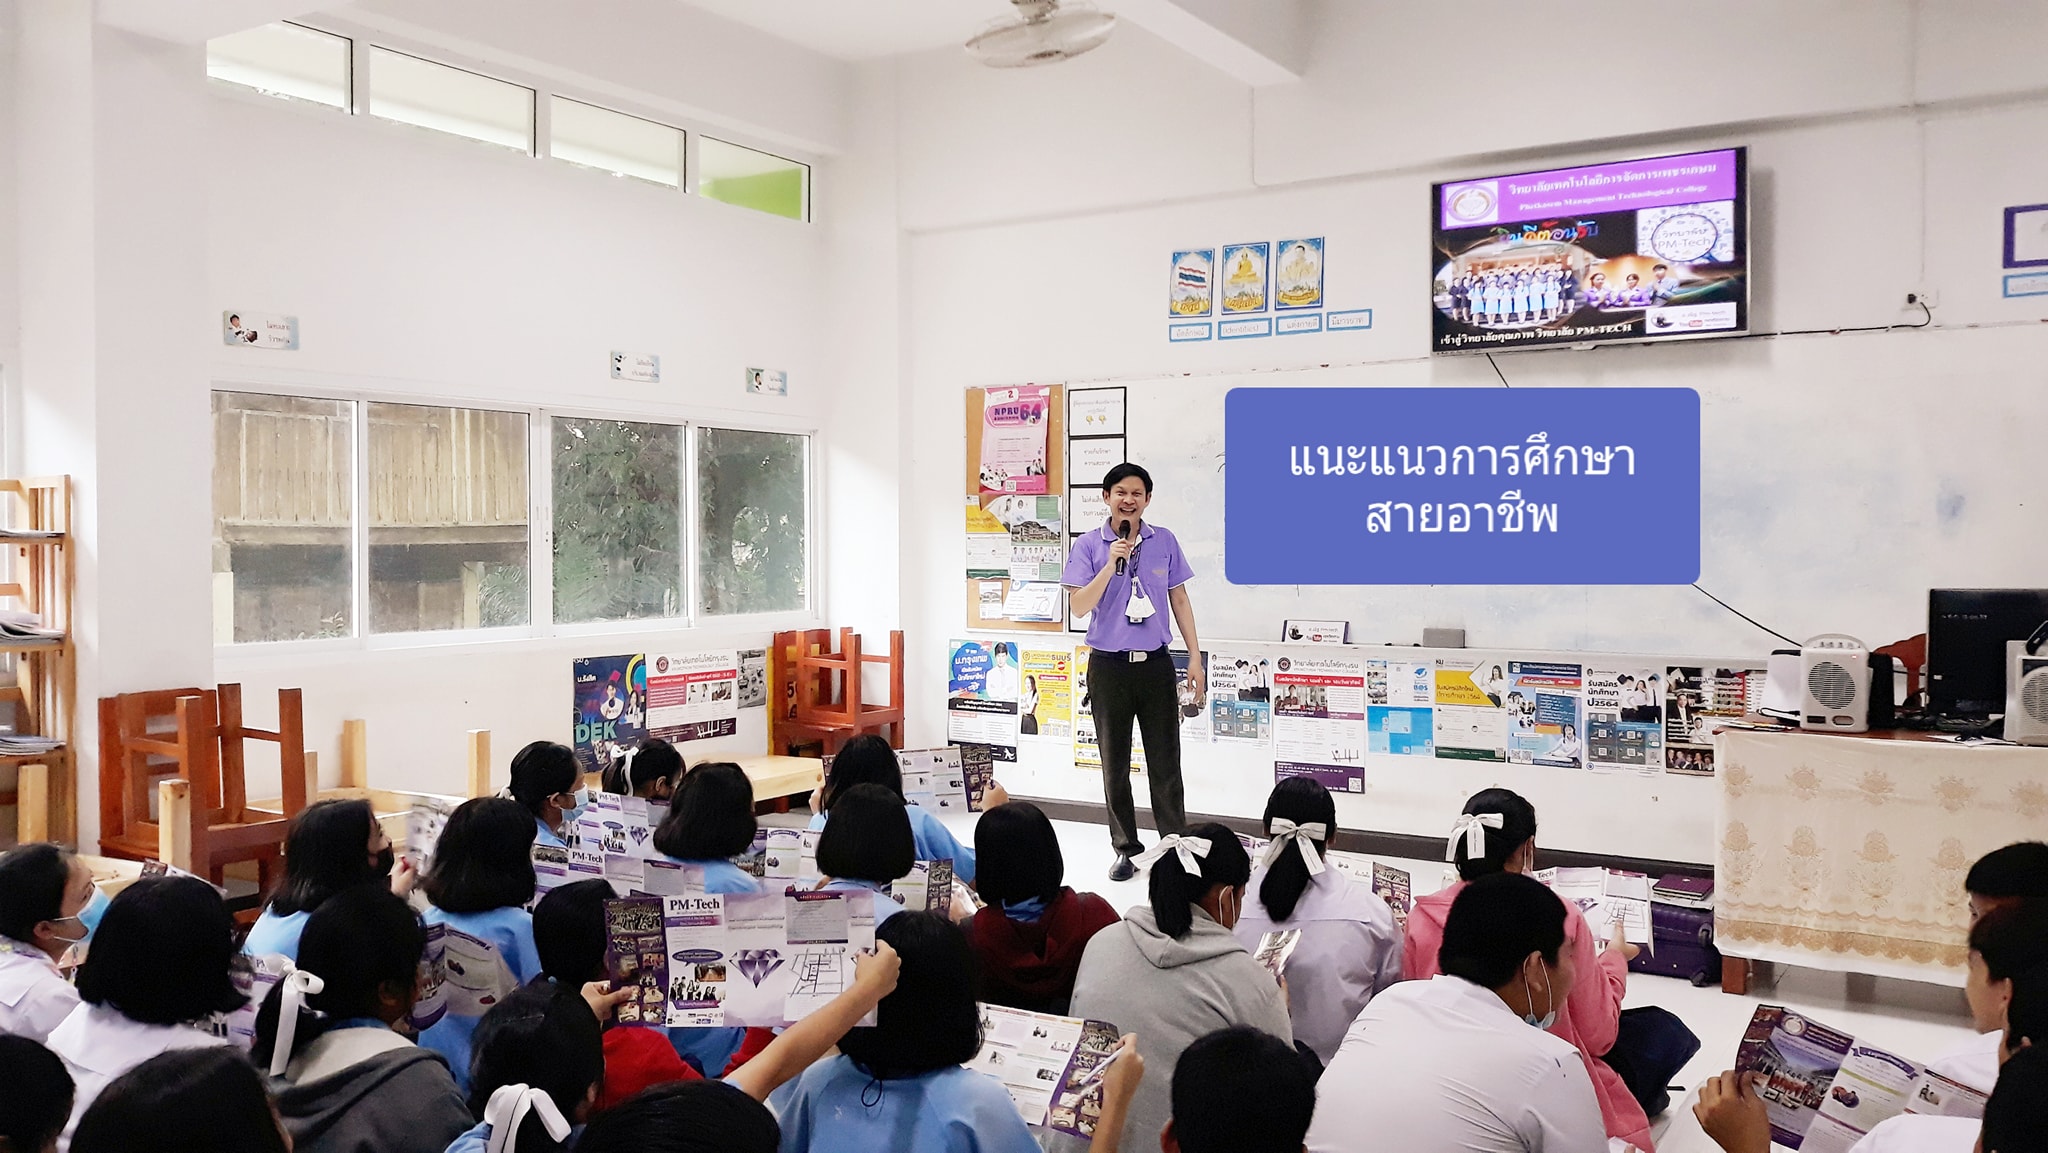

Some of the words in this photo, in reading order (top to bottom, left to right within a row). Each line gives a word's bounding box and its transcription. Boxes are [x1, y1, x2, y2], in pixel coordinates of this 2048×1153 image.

[1657, 237, 1711, 249] PM-Tech
[1576, 323, 1632, 336] PM-TECH
[1008, 390, 1014, 399] 2
[994, 407, 1019, 415] NPRU
[1588, 679, 1618, 688] รับสมัคร
[1588, 688, 1619, 697] นักศึกษา
[575, 719, 618, 744] DEK
[599, 793, 621, 804] PM-Tech
[572, 851, 603, 864] PM-Tech
[1537, 870, 1554, 879] Tech
[670, 898, 720, 911] PM-Tech
